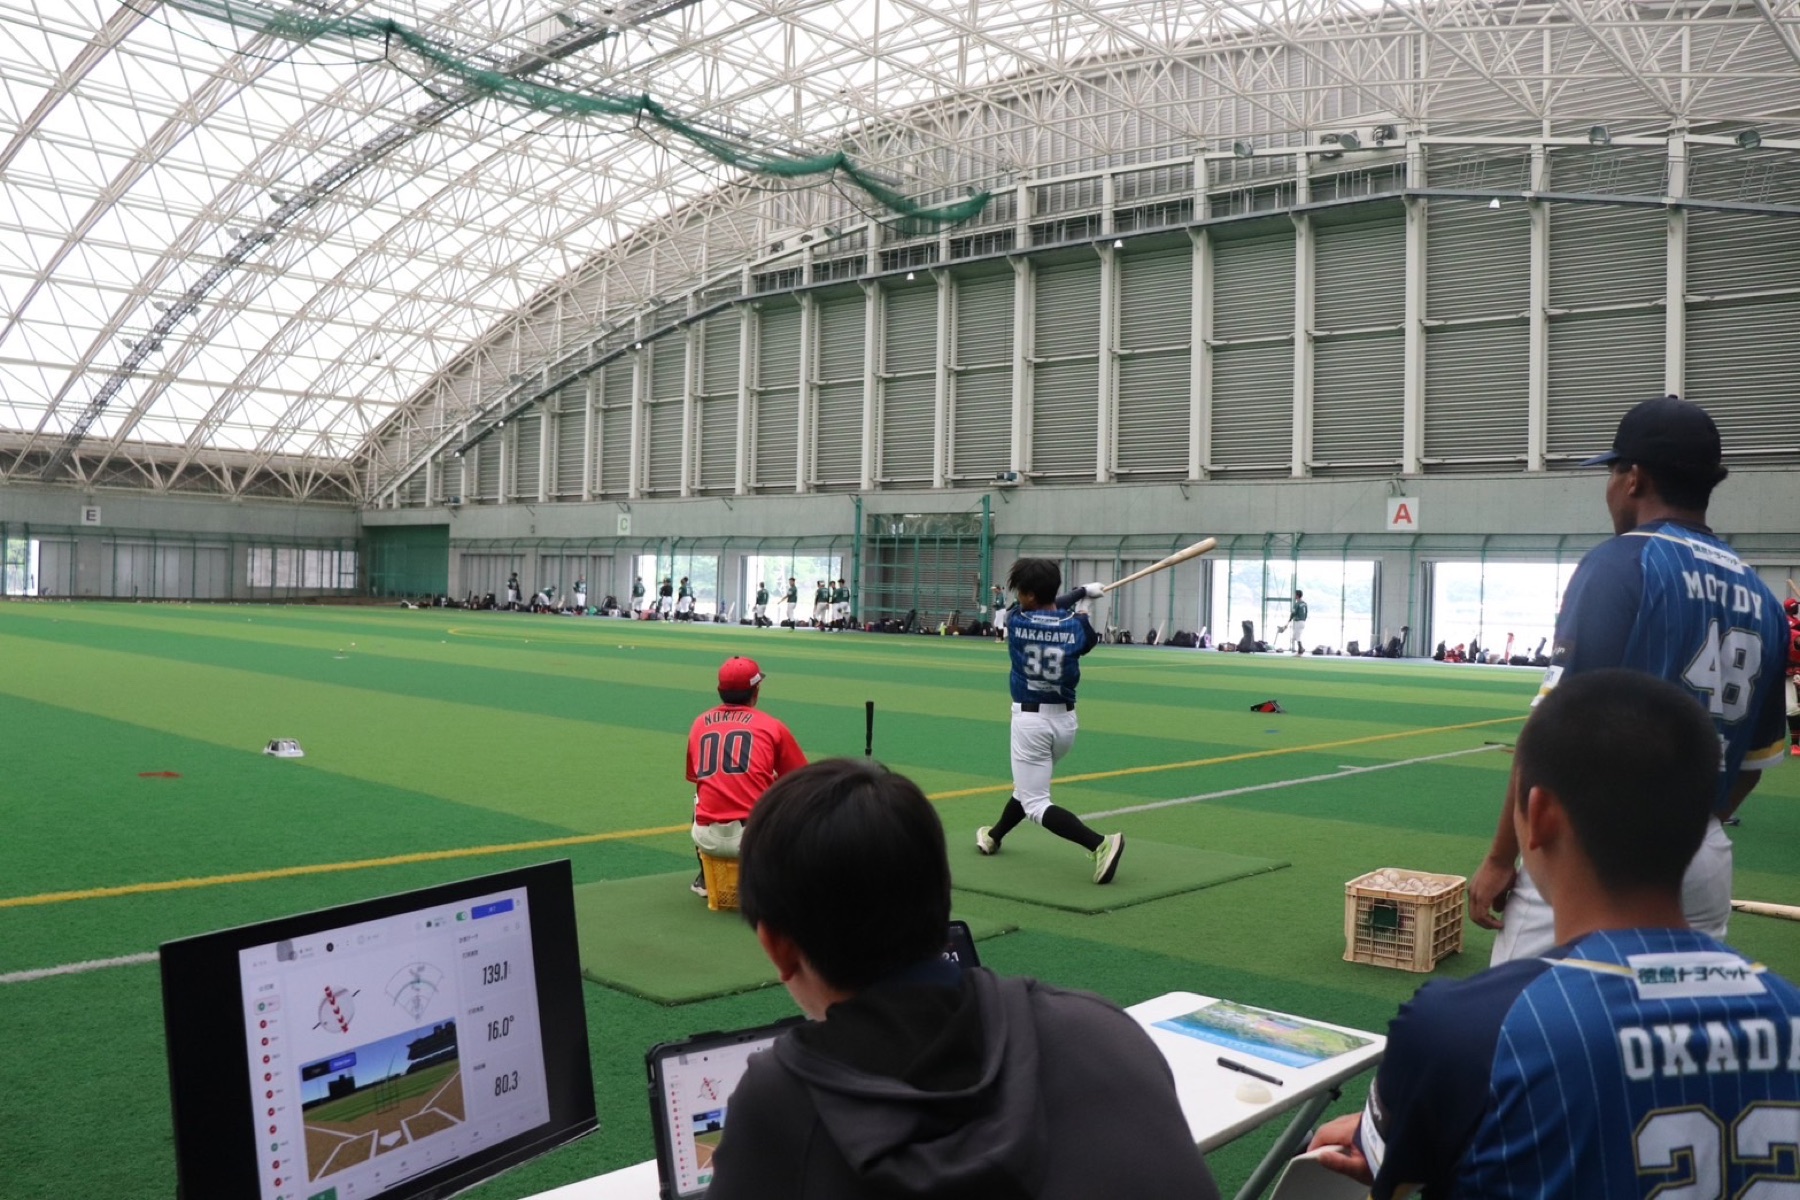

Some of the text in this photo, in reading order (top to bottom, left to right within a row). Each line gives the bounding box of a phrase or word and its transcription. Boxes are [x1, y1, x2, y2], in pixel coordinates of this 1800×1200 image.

[86, 509, 97, 521] E
[620, 517, 629, 531] C
[1392, 503, 1412, 524] A
[1014, 627, 1076, 644] NAKAGAWA
[1023, 644, 1065, 680] 33
[1681, 617, 1762, 723] 48
[697, 729, 753, 779] 00
[483, 961, 508, 985] 139.1
[1637, 965, 1749, 985] 徳島トヨペット
[495, 1070, 518, 1096] 80.3
